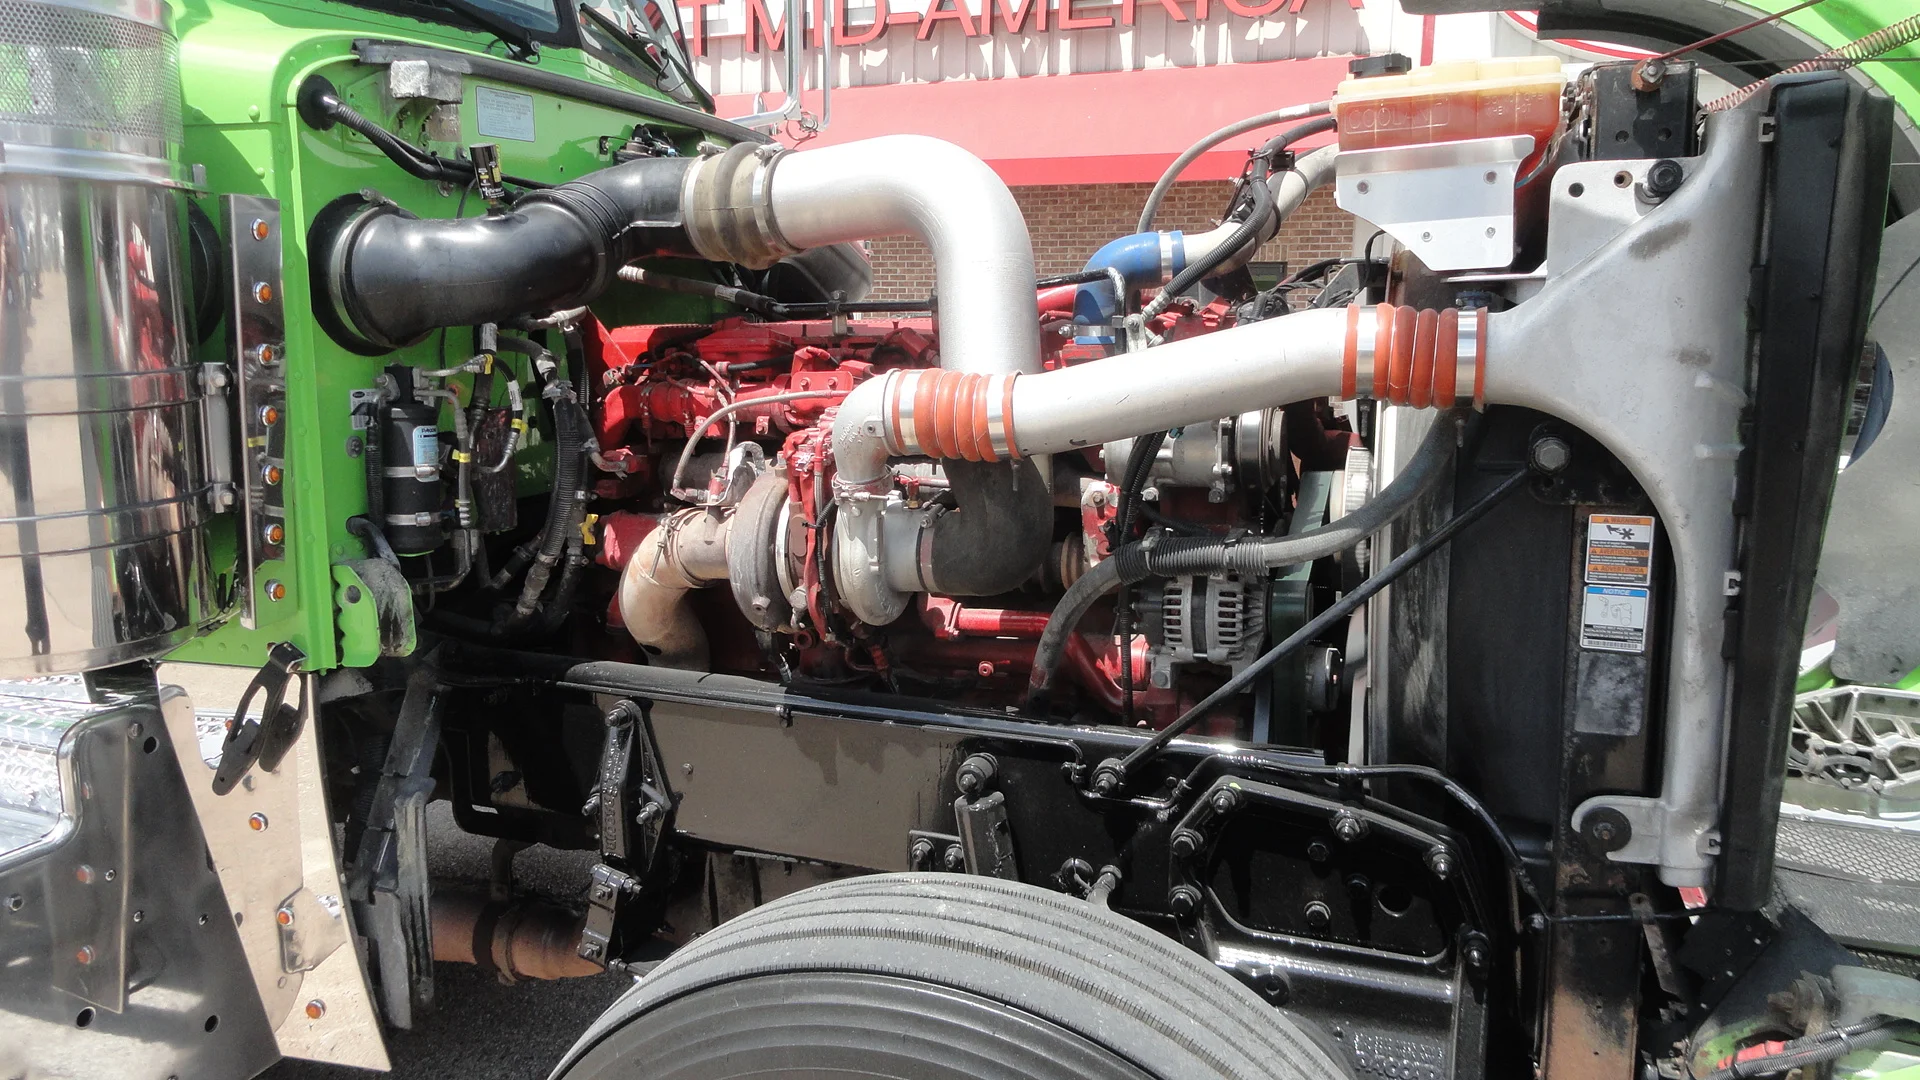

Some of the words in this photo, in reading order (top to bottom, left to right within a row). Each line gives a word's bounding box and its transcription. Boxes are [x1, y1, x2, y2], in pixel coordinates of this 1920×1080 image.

[744, 0, 1365, 53] MID-AM
[1611, 517, 1640, 525] WARNING
[1600, 565, 1644, 574] ADVERTENCIA
[1602, 588, 1630, 596] NOTICE
